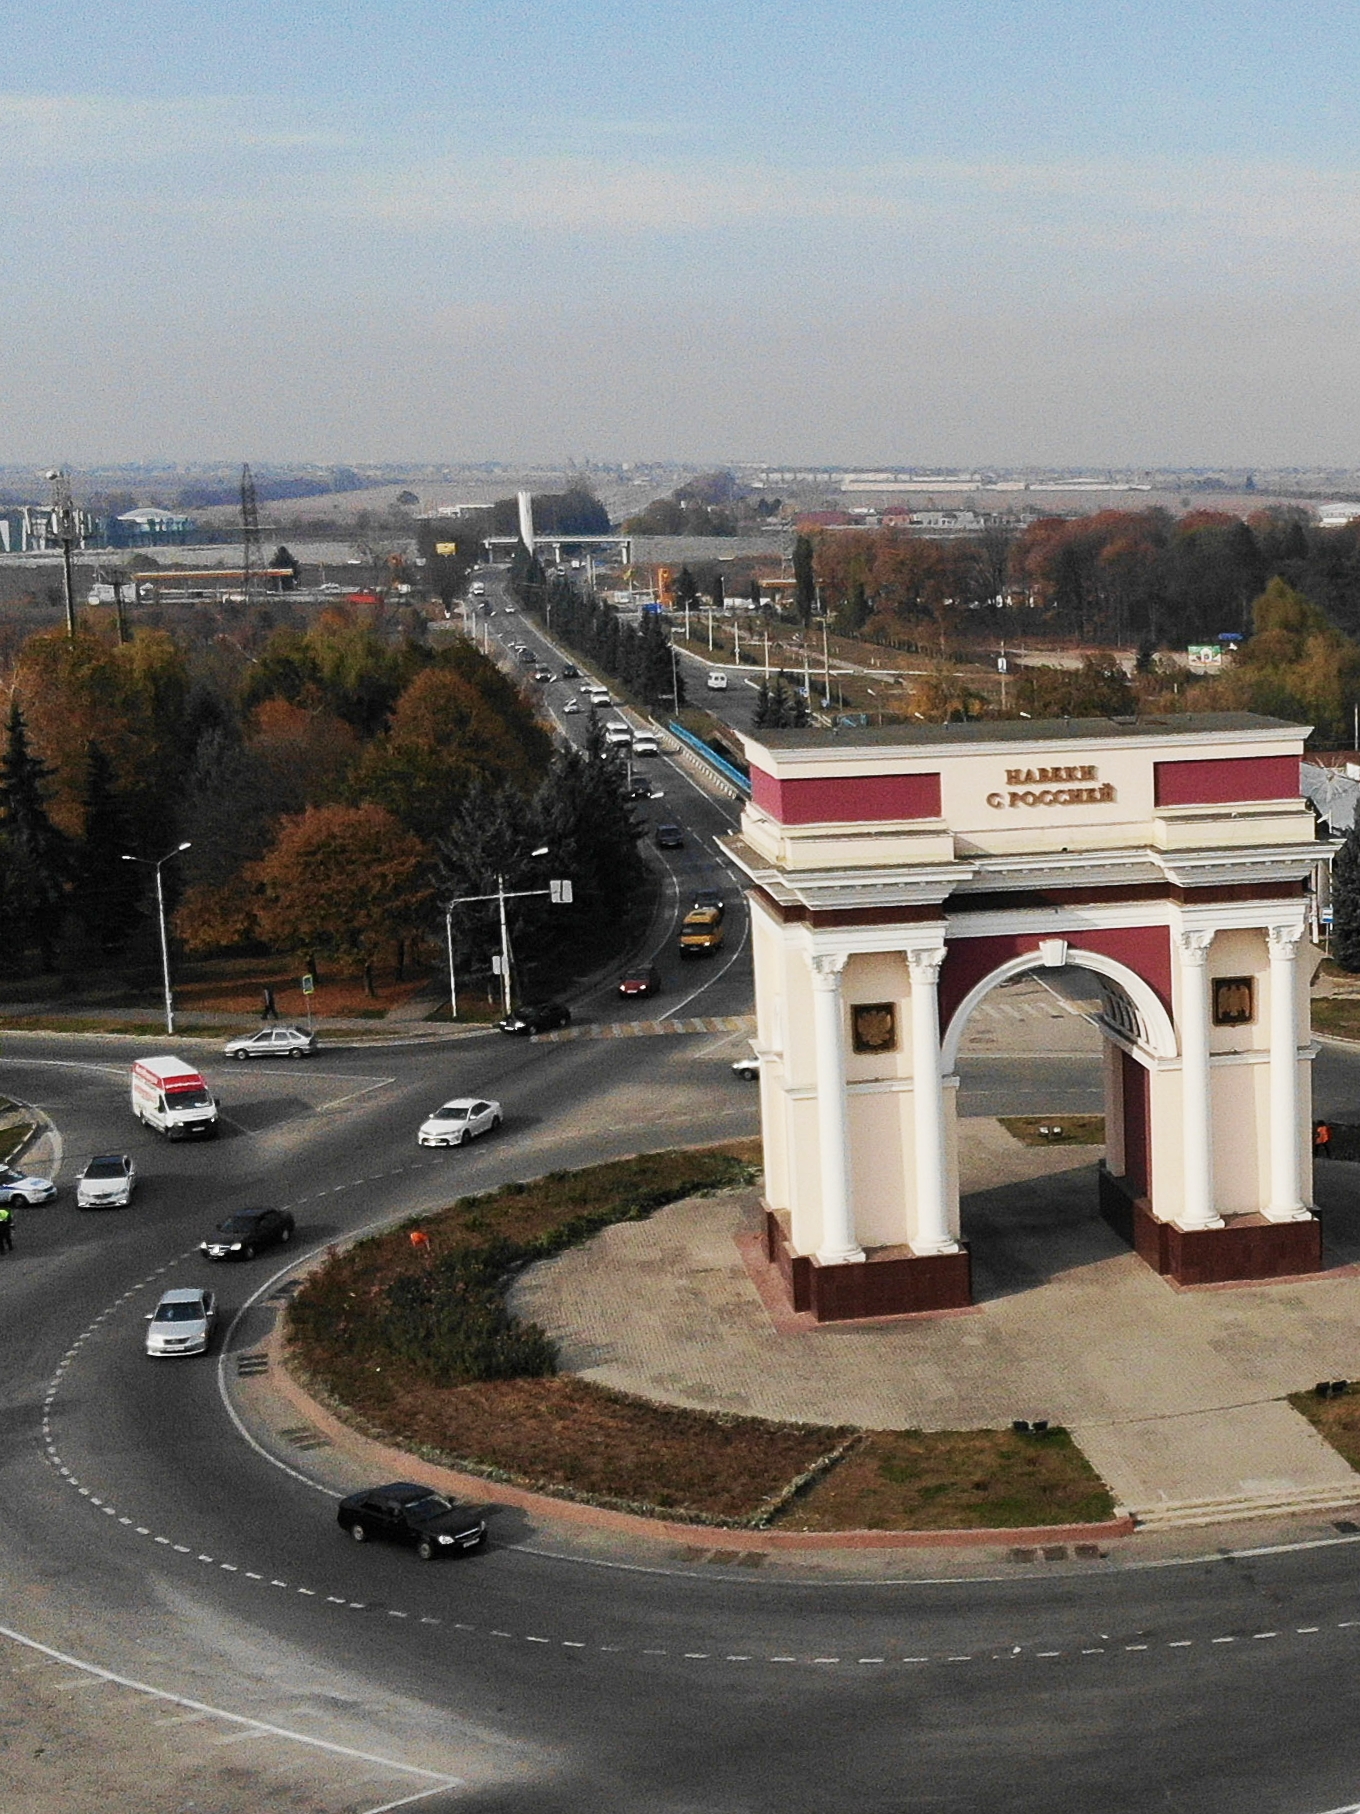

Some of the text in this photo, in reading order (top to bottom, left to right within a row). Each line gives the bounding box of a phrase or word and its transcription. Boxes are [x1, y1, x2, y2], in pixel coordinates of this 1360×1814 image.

[1005, 765, 1098, 785] НАВЕКИ
[986, 783, 1118, 809] С РОССИЕЙ
